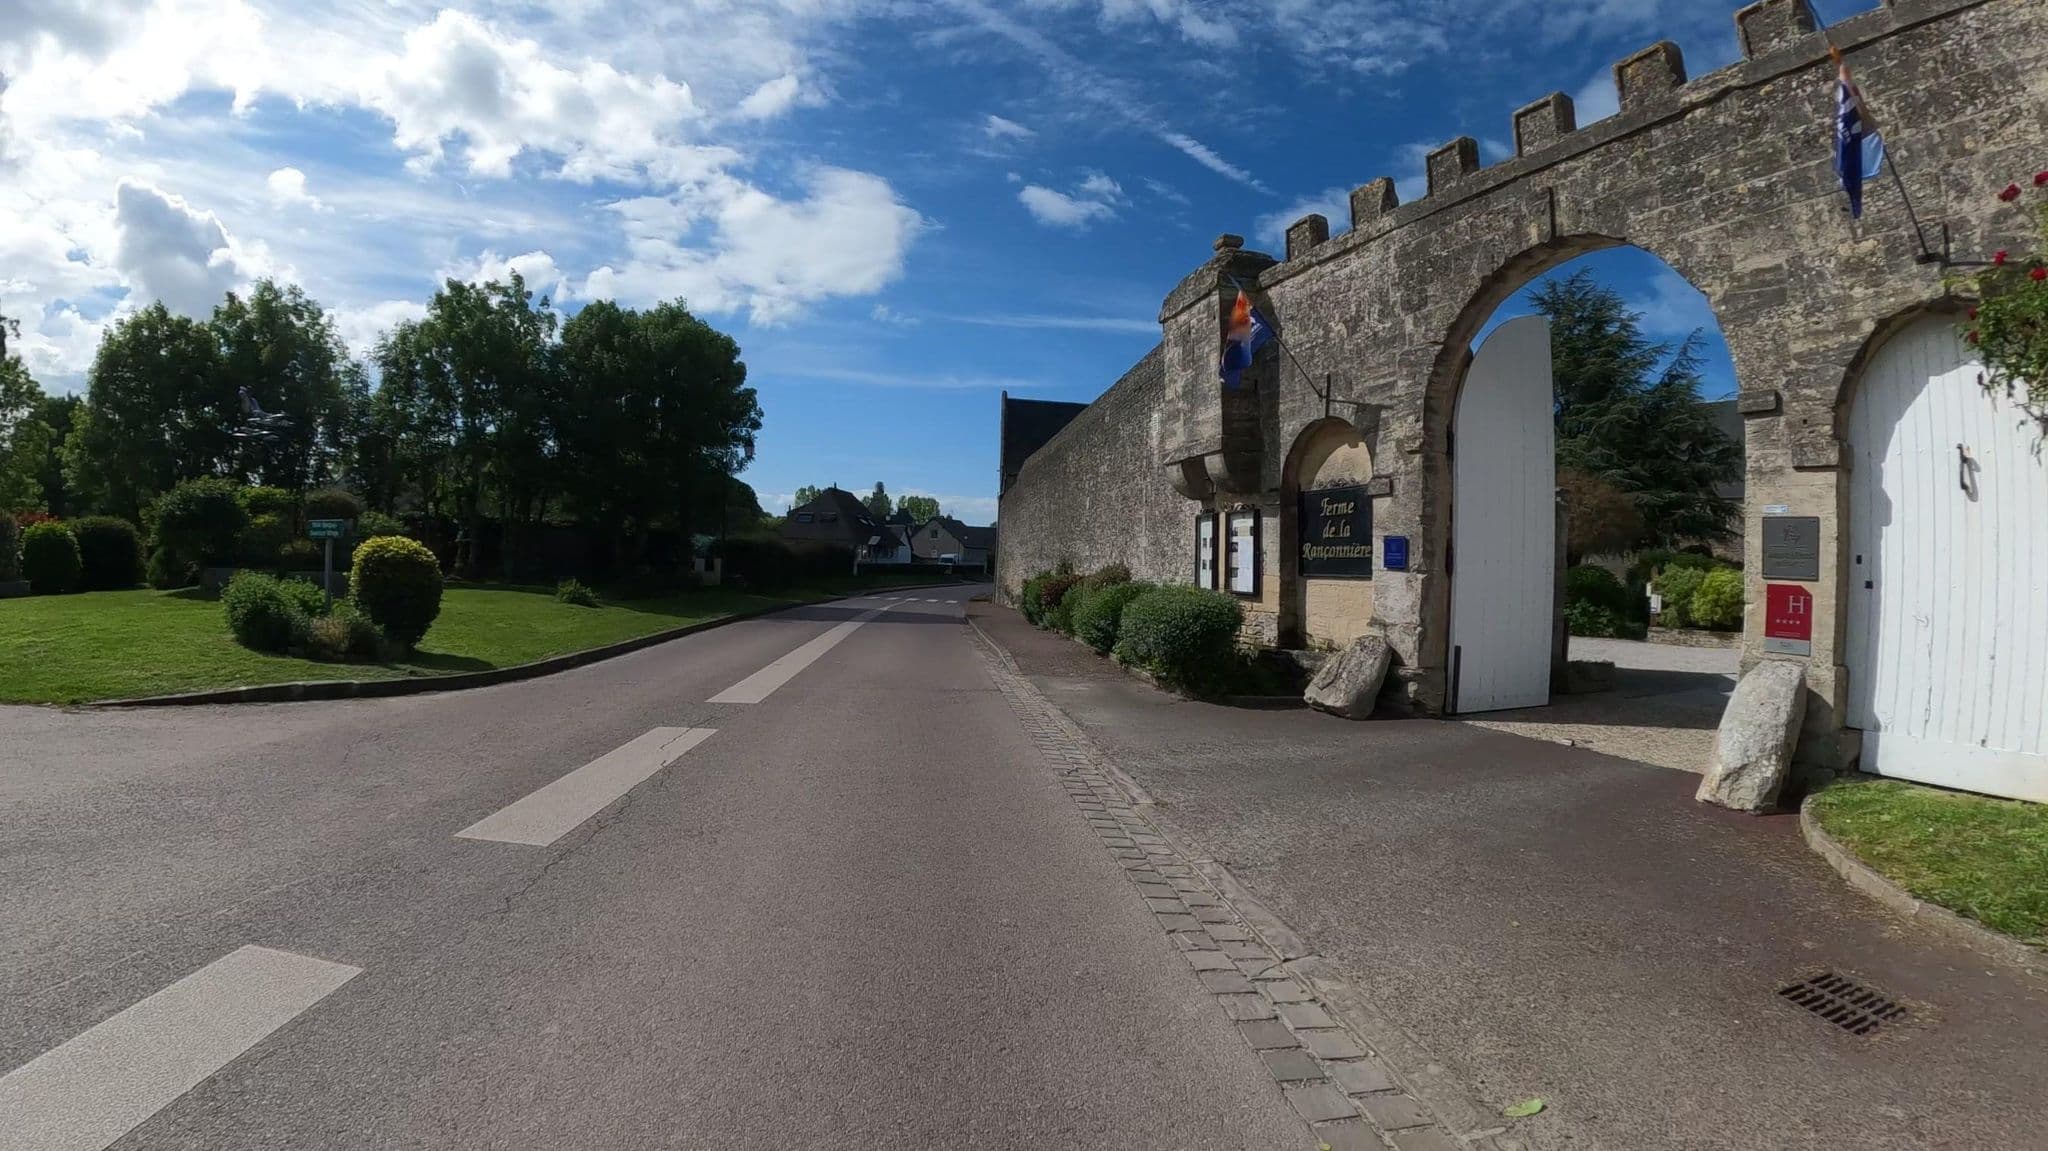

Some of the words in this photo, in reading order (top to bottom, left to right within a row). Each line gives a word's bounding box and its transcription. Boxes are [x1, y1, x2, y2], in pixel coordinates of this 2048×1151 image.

[1319, 497, 1355, 517] Ferme
[1323, 519, 1336, 538] de
[1340, 519, 1351, 537] la
[1302, 542, 1372, 561] Rançonnière
[1787, 595, 1806, 614] H
